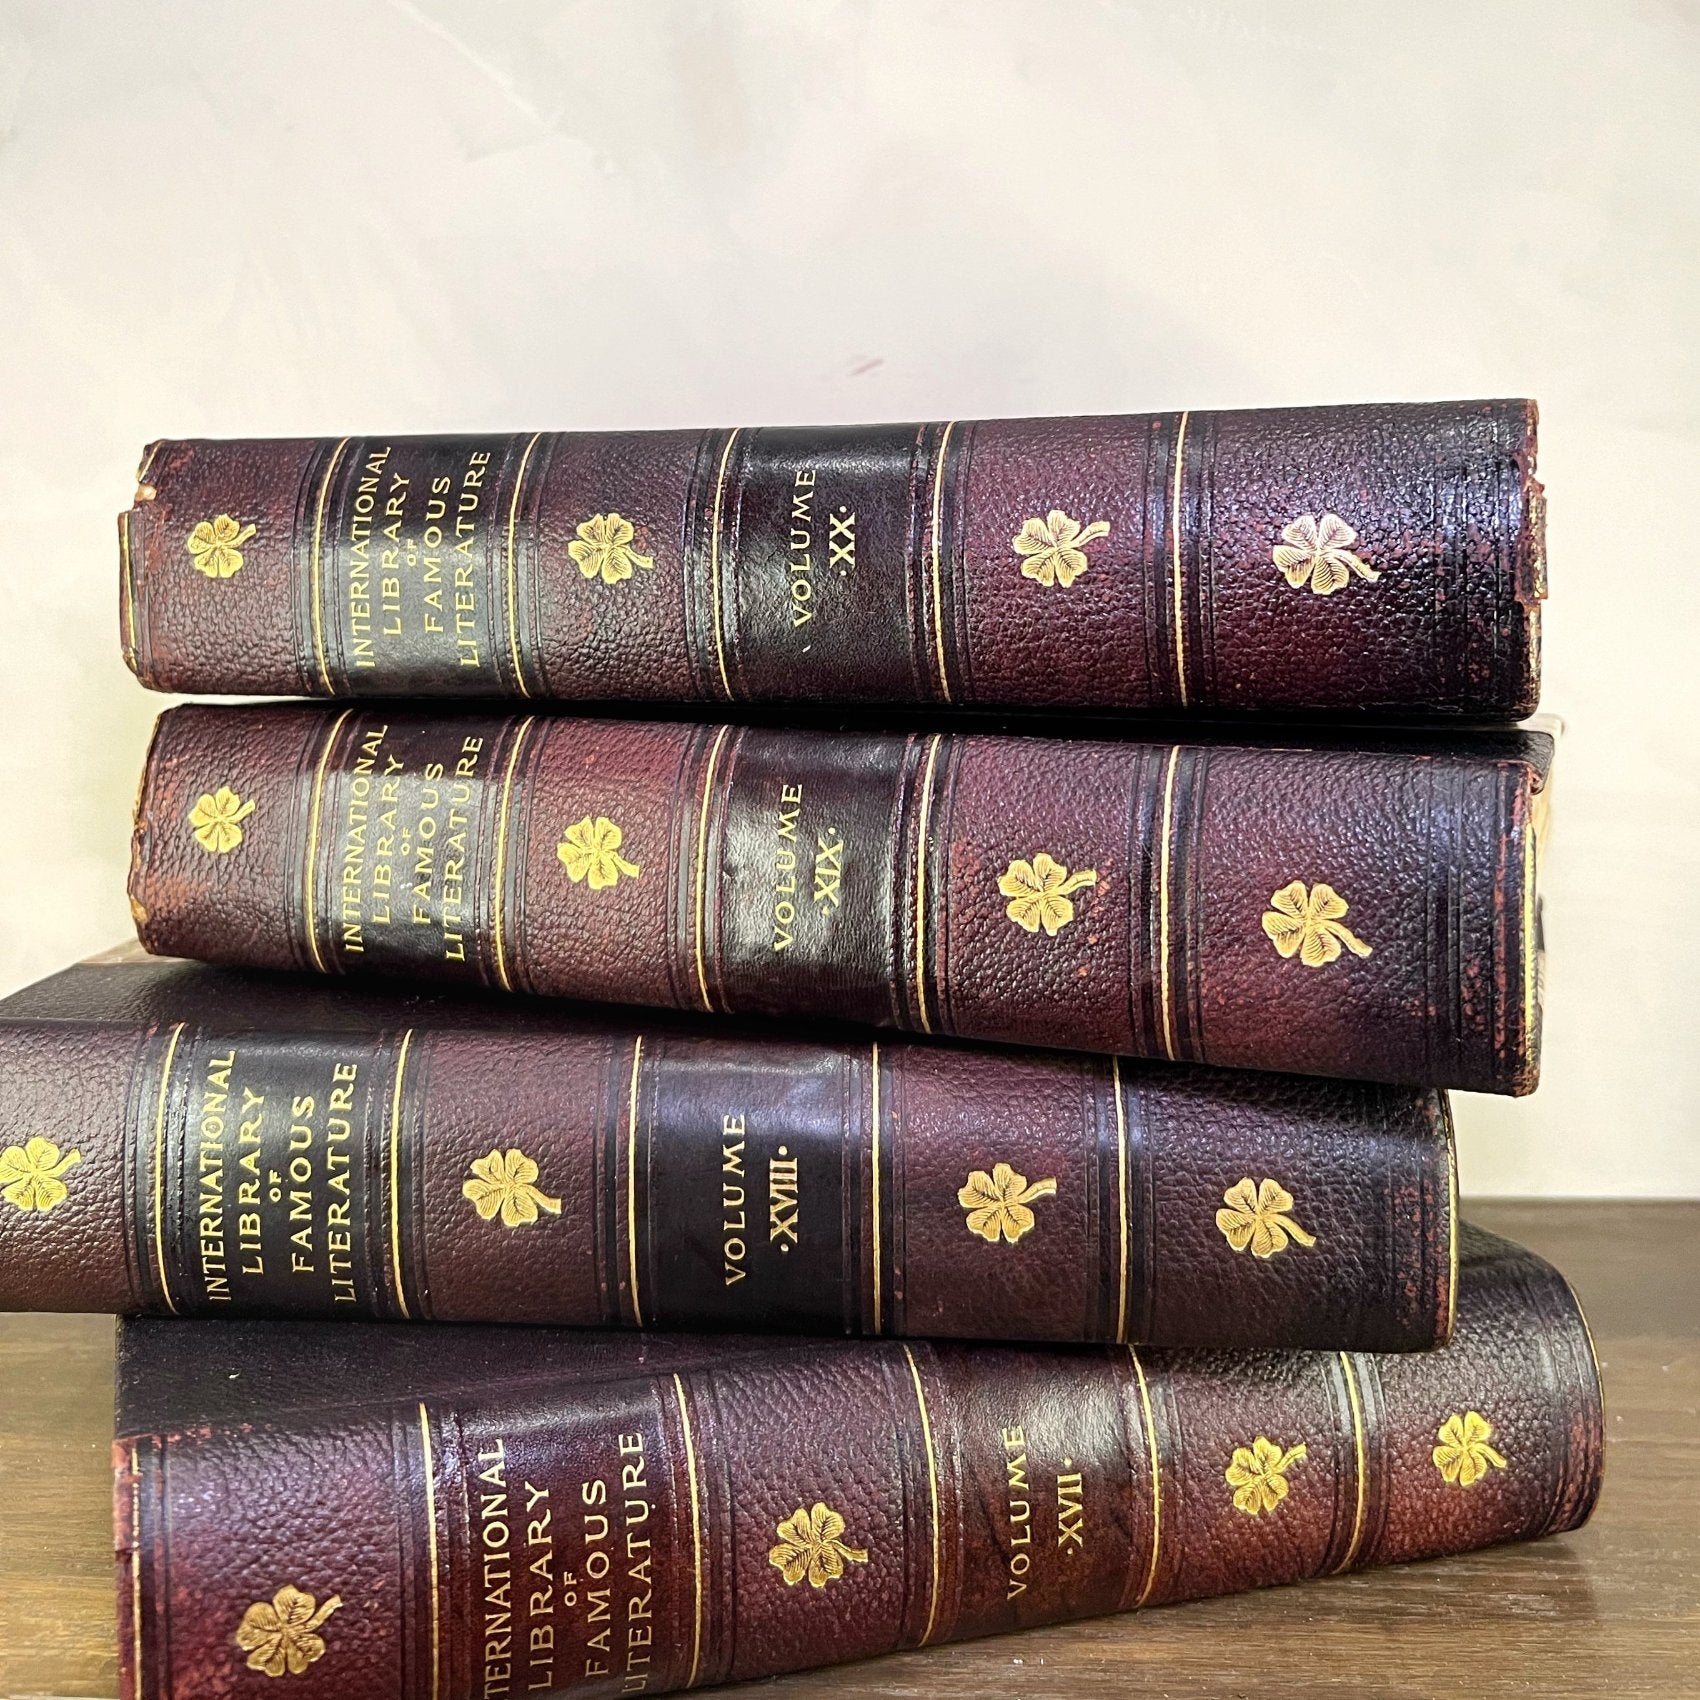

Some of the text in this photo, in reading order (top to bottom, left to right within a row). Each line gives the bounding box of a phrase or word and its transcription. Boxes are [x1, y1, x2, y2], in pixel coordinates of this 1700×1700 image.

[349, 446, 392, 668] INTERNATIONAL
[381, 472, 411, 636] LIBRARY
[406, 538, 418, 567] OF
[423, 475, 451, 634] FAMOUS
[454, 451, 491, 668] LITERATURE
[790, 469, 816, 628] VOLUME
[342, 724, 389, 953] INTERNATIONAL
[373, 754, 404, 925] LIBRARY
[400, 826, 412, 856] OF
[412, 763, 444, 924] FAMOUS
[443, 736, 484, 962] LITERATURE
[773, 784, 803, 952] VOLUME
[199, 1050, 236, 1301] INTERNATIONAL
[238, 1087, 265, 1275] LIBRARY
[269, 1169, 282, 1203] OF
[289, 1095, 315, 1273] FAMOUS
[327, 1062, 358, 1303] LITERATURE
[722, 1114, 747, 1286] VOLUME
[477, 1438, 512, 1700] TERNATIONAL
[523, 1481, 555, 1691] LIBRARY
[563, 1571, 578, 1607] OF
[581, 1479, 611, 1677] FAMOUS
[617, 1432, 652, 1694] LITERATURE
[1001, 1425, 1032, 1600] VOLUME
